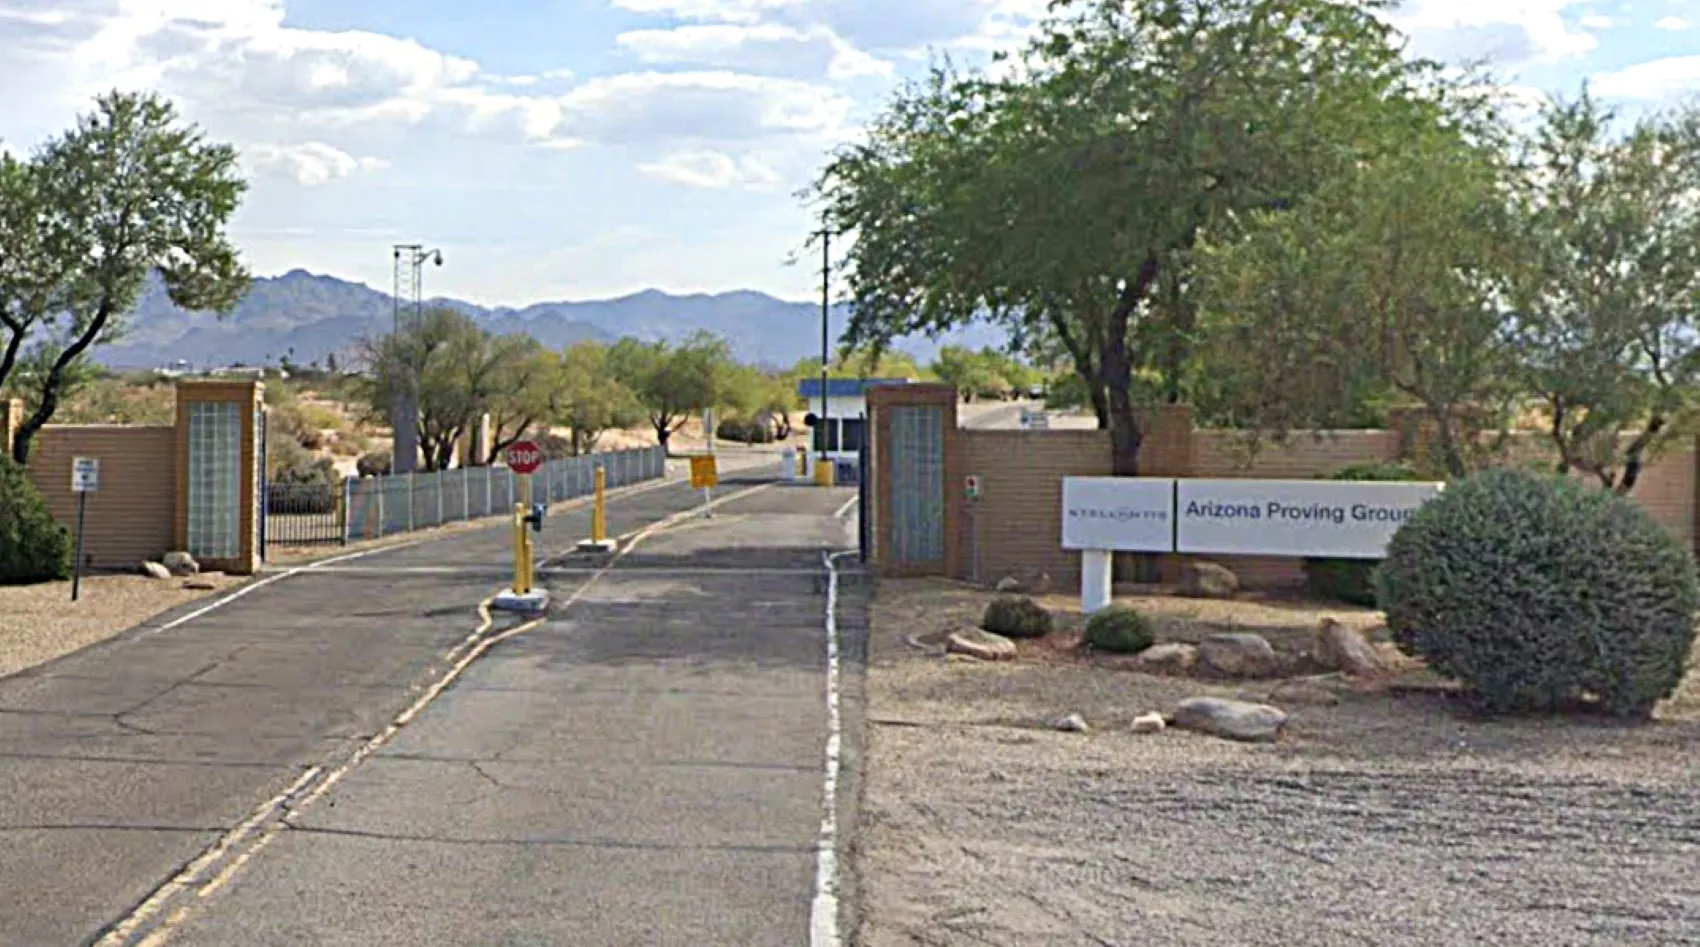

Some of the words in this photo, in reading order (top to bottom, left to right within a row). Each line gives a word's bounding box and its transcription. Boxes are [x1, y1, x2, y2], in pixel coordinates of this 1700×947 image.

[508, 449, 538, 465] STOP
[1185, 499, 1262, 518] Arizona
[1266, 502, 1346, 525] Proving
